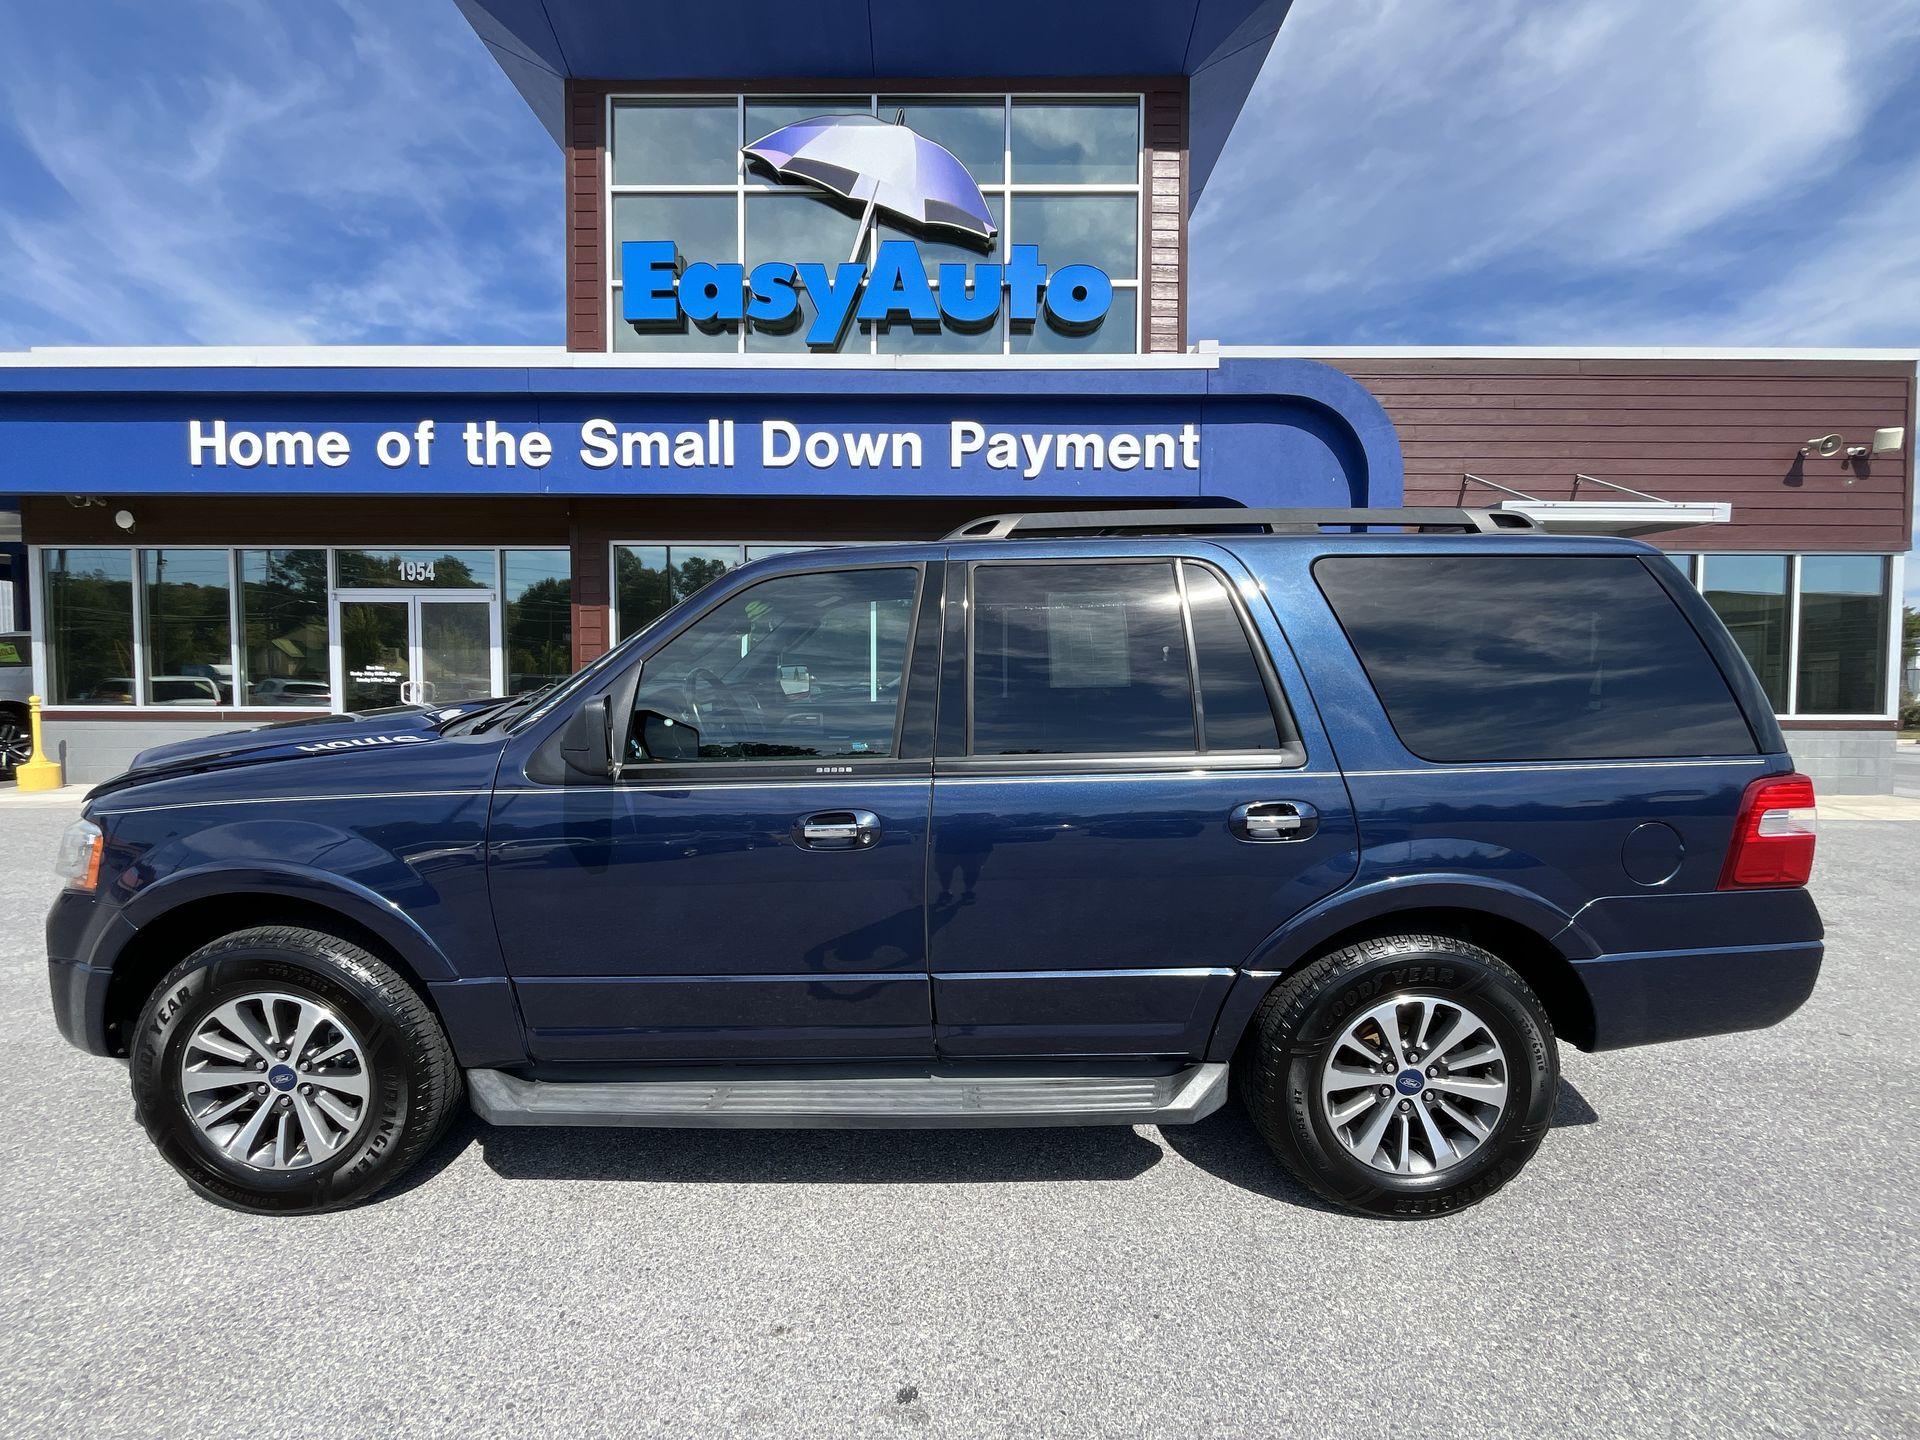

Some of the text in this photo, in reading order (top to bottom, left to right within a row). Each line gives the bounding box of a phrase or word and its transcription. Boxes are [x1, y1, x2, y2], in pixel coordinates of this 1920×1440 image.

[621, 240, 1114, 347] EasyAuto
[189, 418, 1200, 478] Home of the Small Down Payment
[398, 561, 436, 581] 1954
